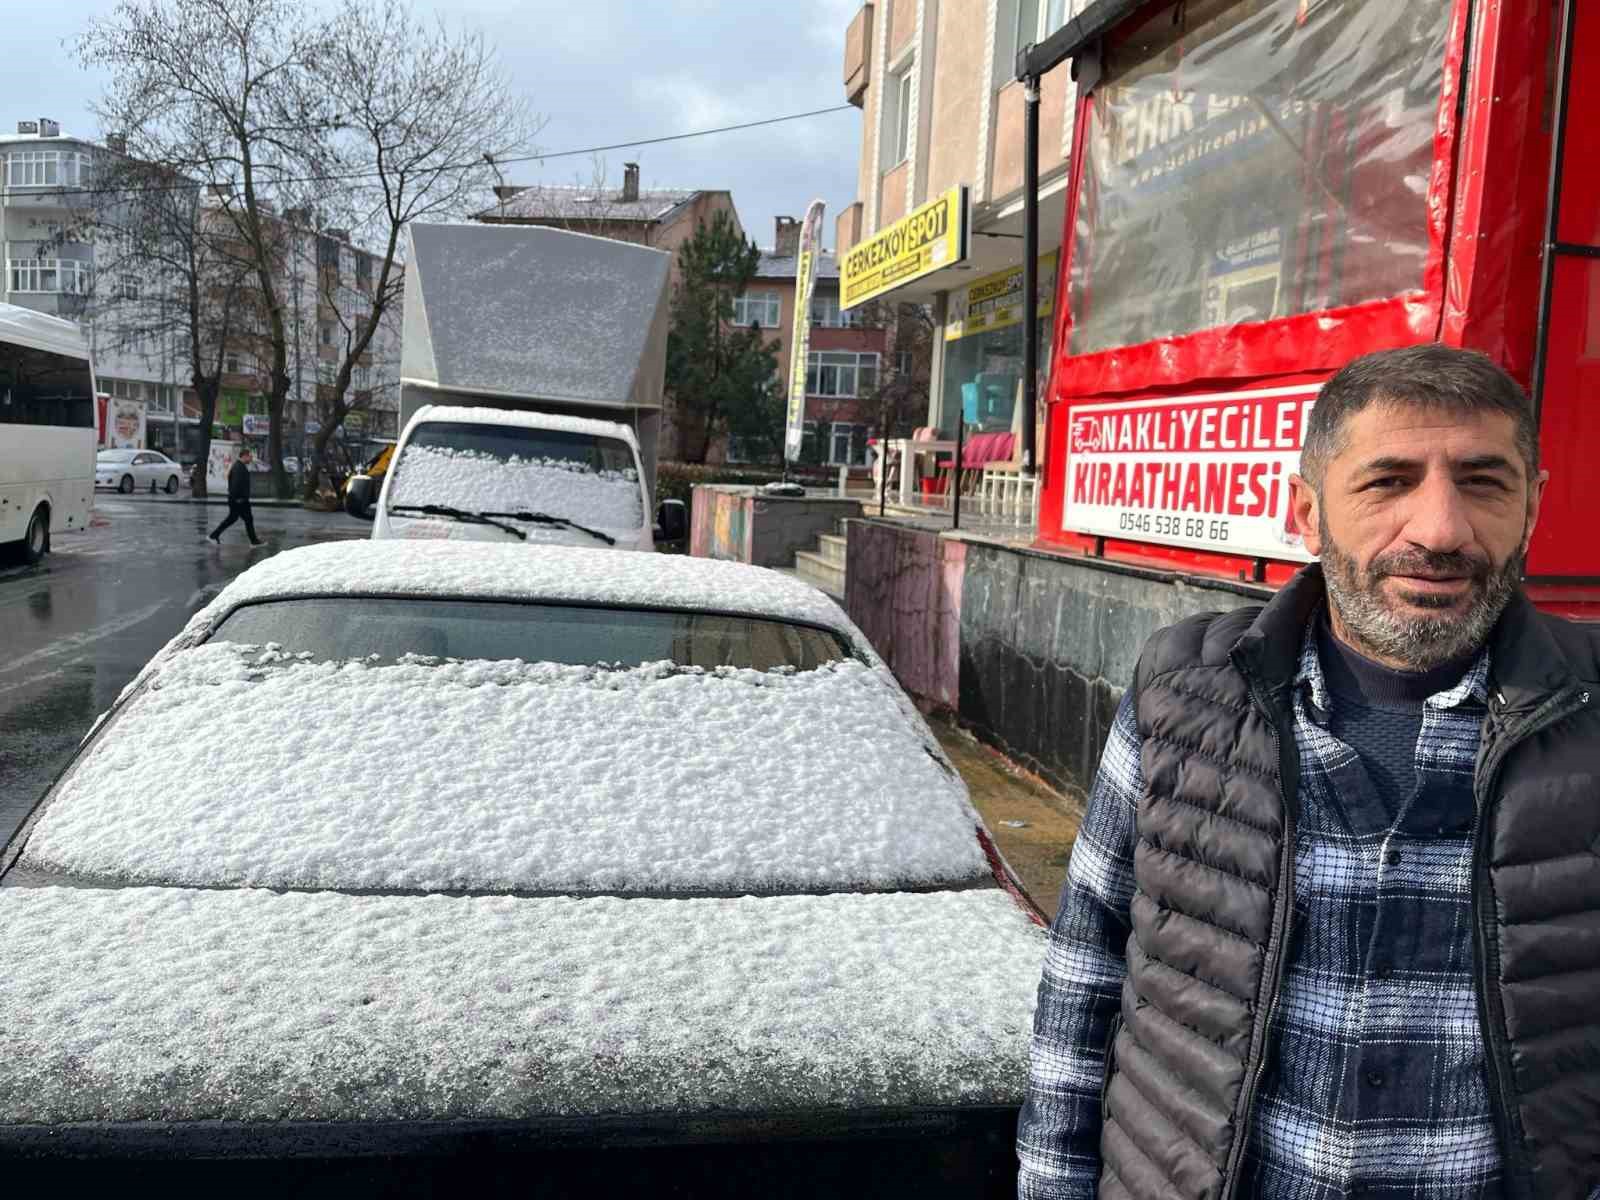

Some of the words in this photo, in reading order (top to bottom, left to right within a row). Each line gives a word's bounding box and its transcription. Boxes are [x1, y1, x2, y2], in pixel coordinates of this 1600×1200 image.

[1073, 461, 1282, 518] KIRAATHANESİ
[1119, 512, 1151, 533] 0546
[1155, 515, 1181, 536] 538
[1185, 518, 1204, 538] 68
[1209, 520, 1230, 541] 66
